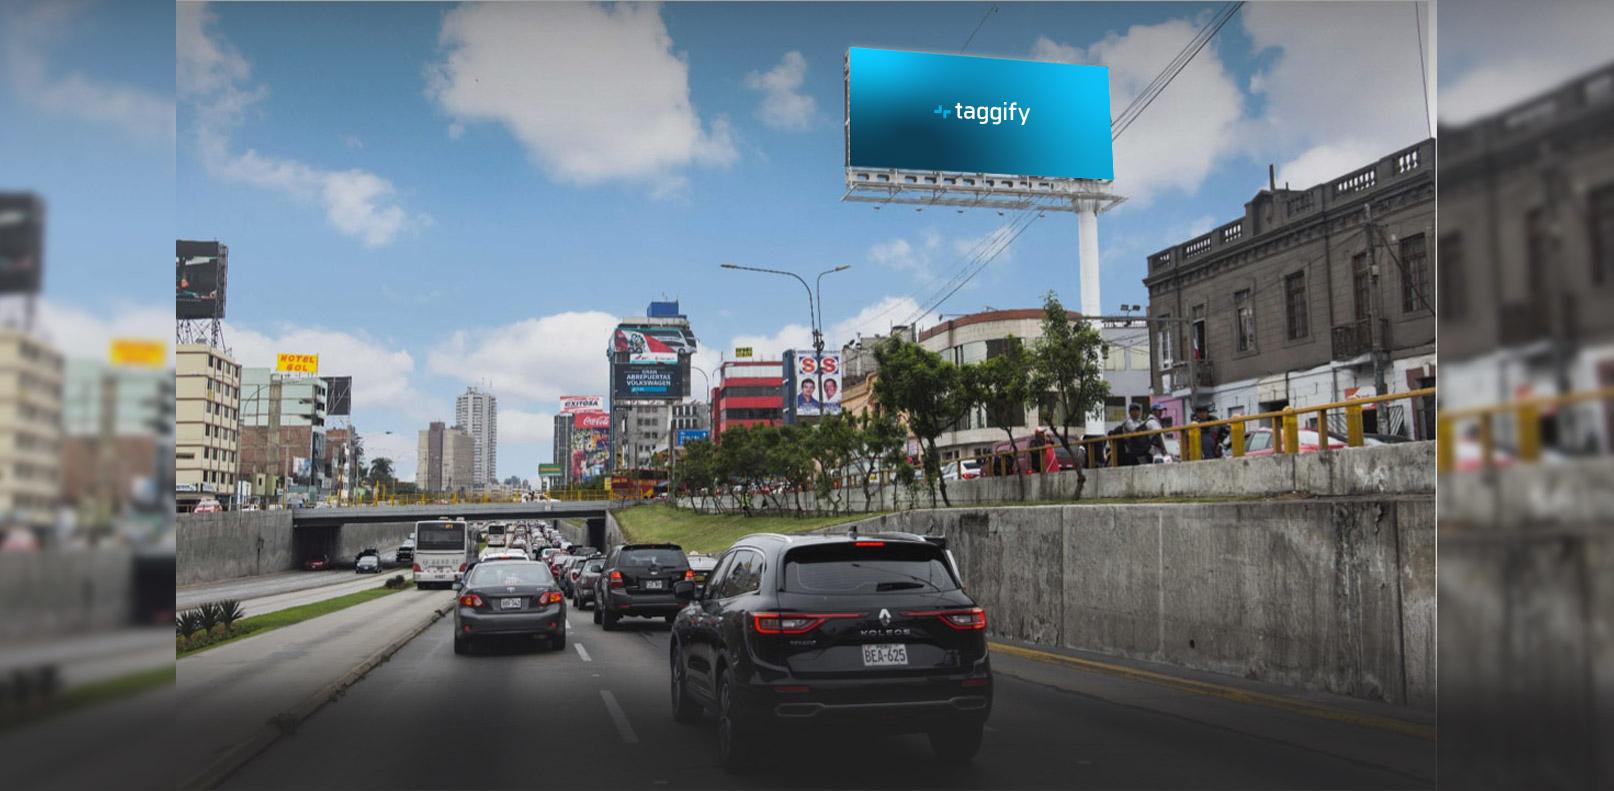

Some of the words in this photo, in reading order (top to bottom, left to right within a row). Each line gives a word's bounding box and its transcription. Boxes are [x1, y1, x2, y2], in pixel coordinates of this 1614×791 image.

[954, 101, 1031, 126] taggify
[280, 354, 315, 363] HOTEL
[860, 628, 911, 636] KOLEOS
[864, 648, 906, 663] BEA-625
